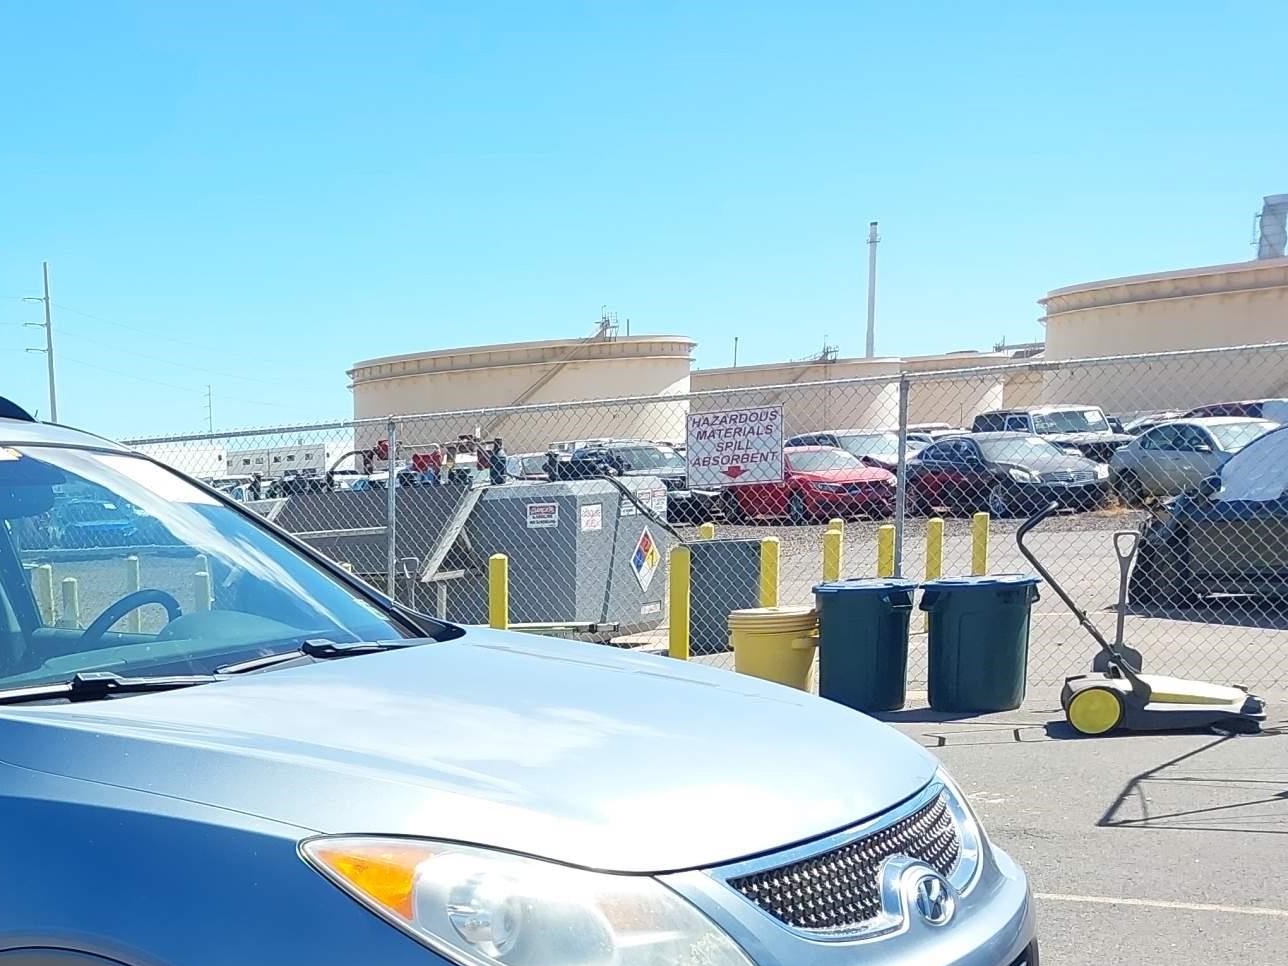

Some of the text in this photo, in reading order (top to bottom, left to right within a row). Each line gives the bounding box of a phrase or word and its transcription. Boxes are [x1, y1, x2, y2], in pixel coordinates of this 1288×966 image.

[691, 410, 779, 428] HAZARDOUS
[696, 424, 774, 440] MATERIALS
[715, 440, 754, 453] SPILL
[691, 451, 779, 467] ABSORBENT
